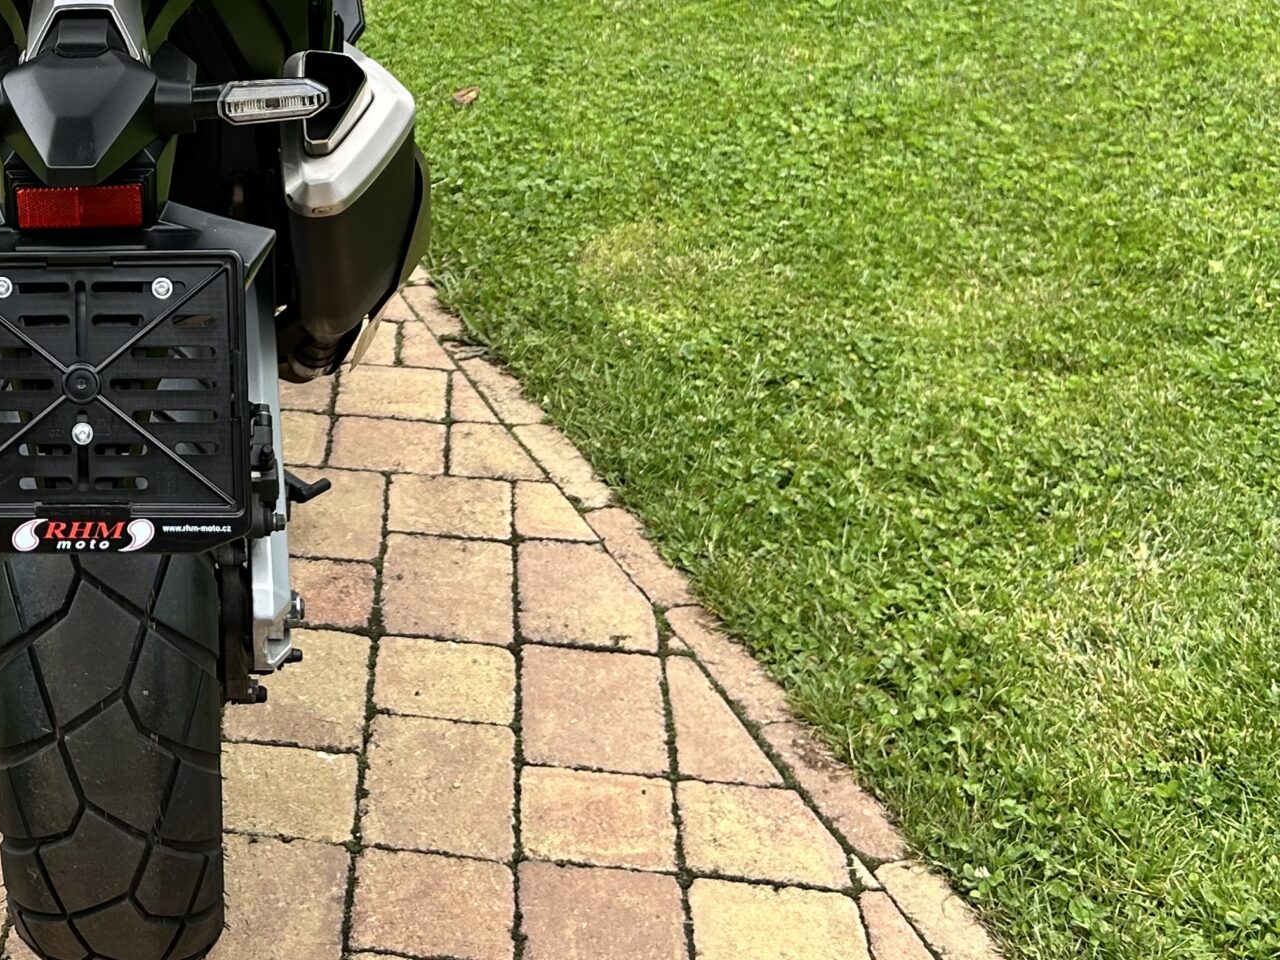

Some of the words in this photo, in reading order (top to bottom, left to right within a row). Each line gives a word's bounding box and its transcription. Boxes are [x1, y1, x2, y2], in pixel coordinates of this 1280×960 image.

[42, 521, 126, 539] RHM
[162, 524, 232, 532] www.rhm-moto.cz
[56, 539, 110, 550] moto
